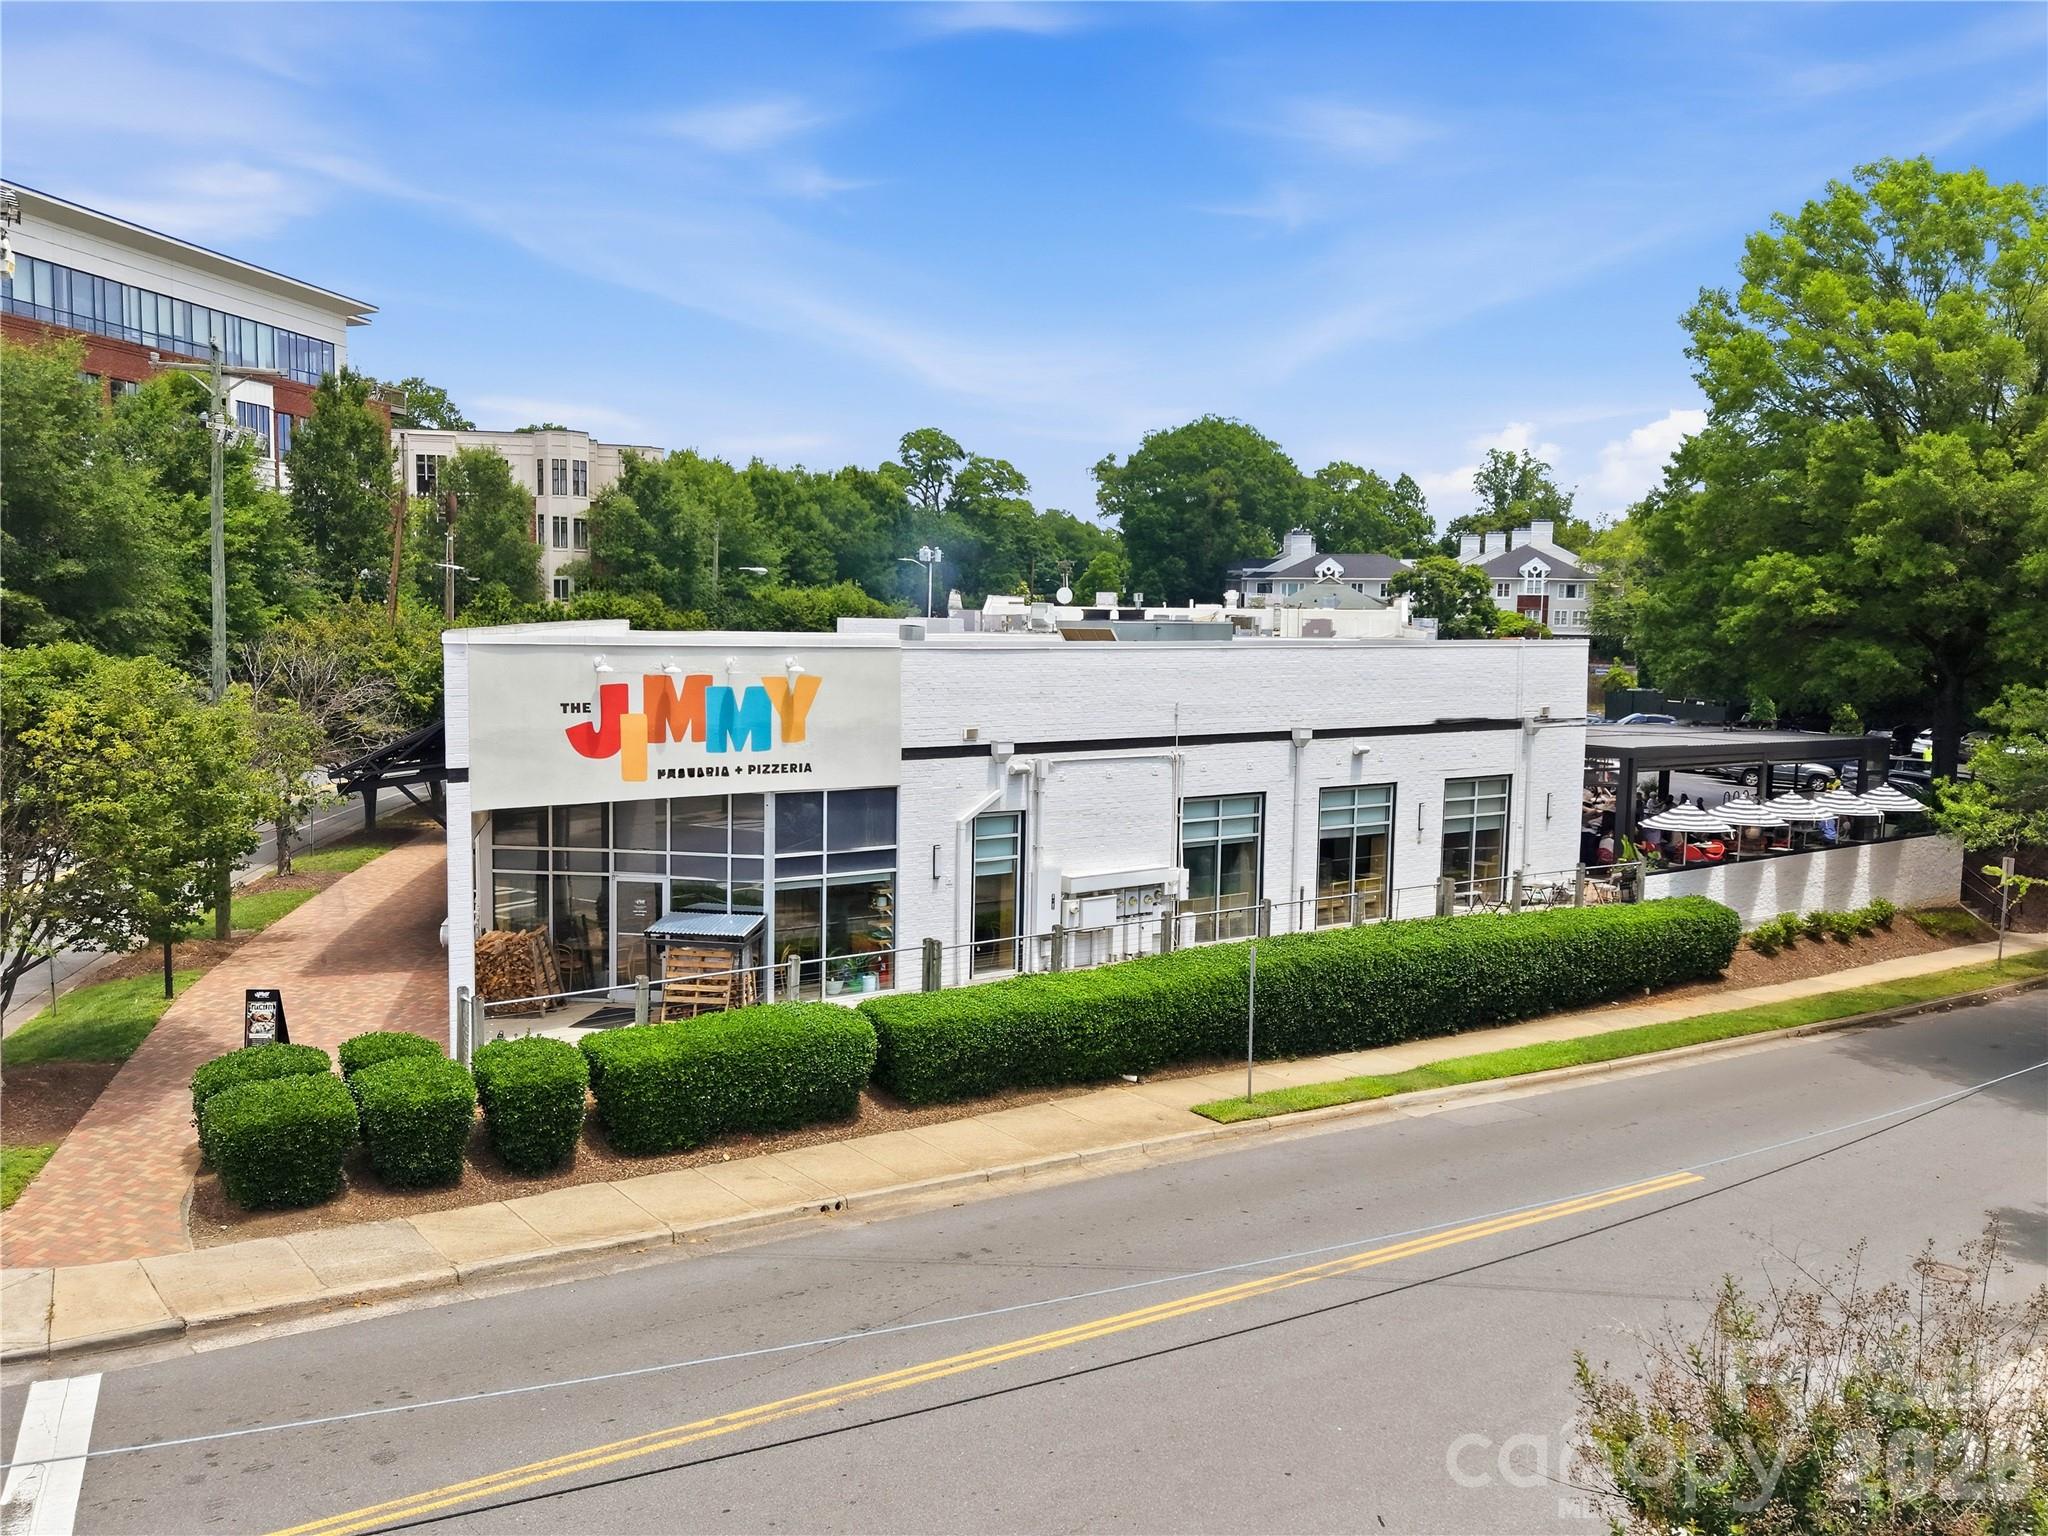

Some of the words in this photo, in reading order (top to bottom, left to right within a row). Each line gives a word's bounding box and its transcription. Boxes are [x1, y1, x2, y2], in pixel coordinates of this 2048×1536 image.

[560, 702, 592, 714] THE
[565, 673, 823, 782] JIMMY
[748, 763, 813, 775] PIZZERIA
